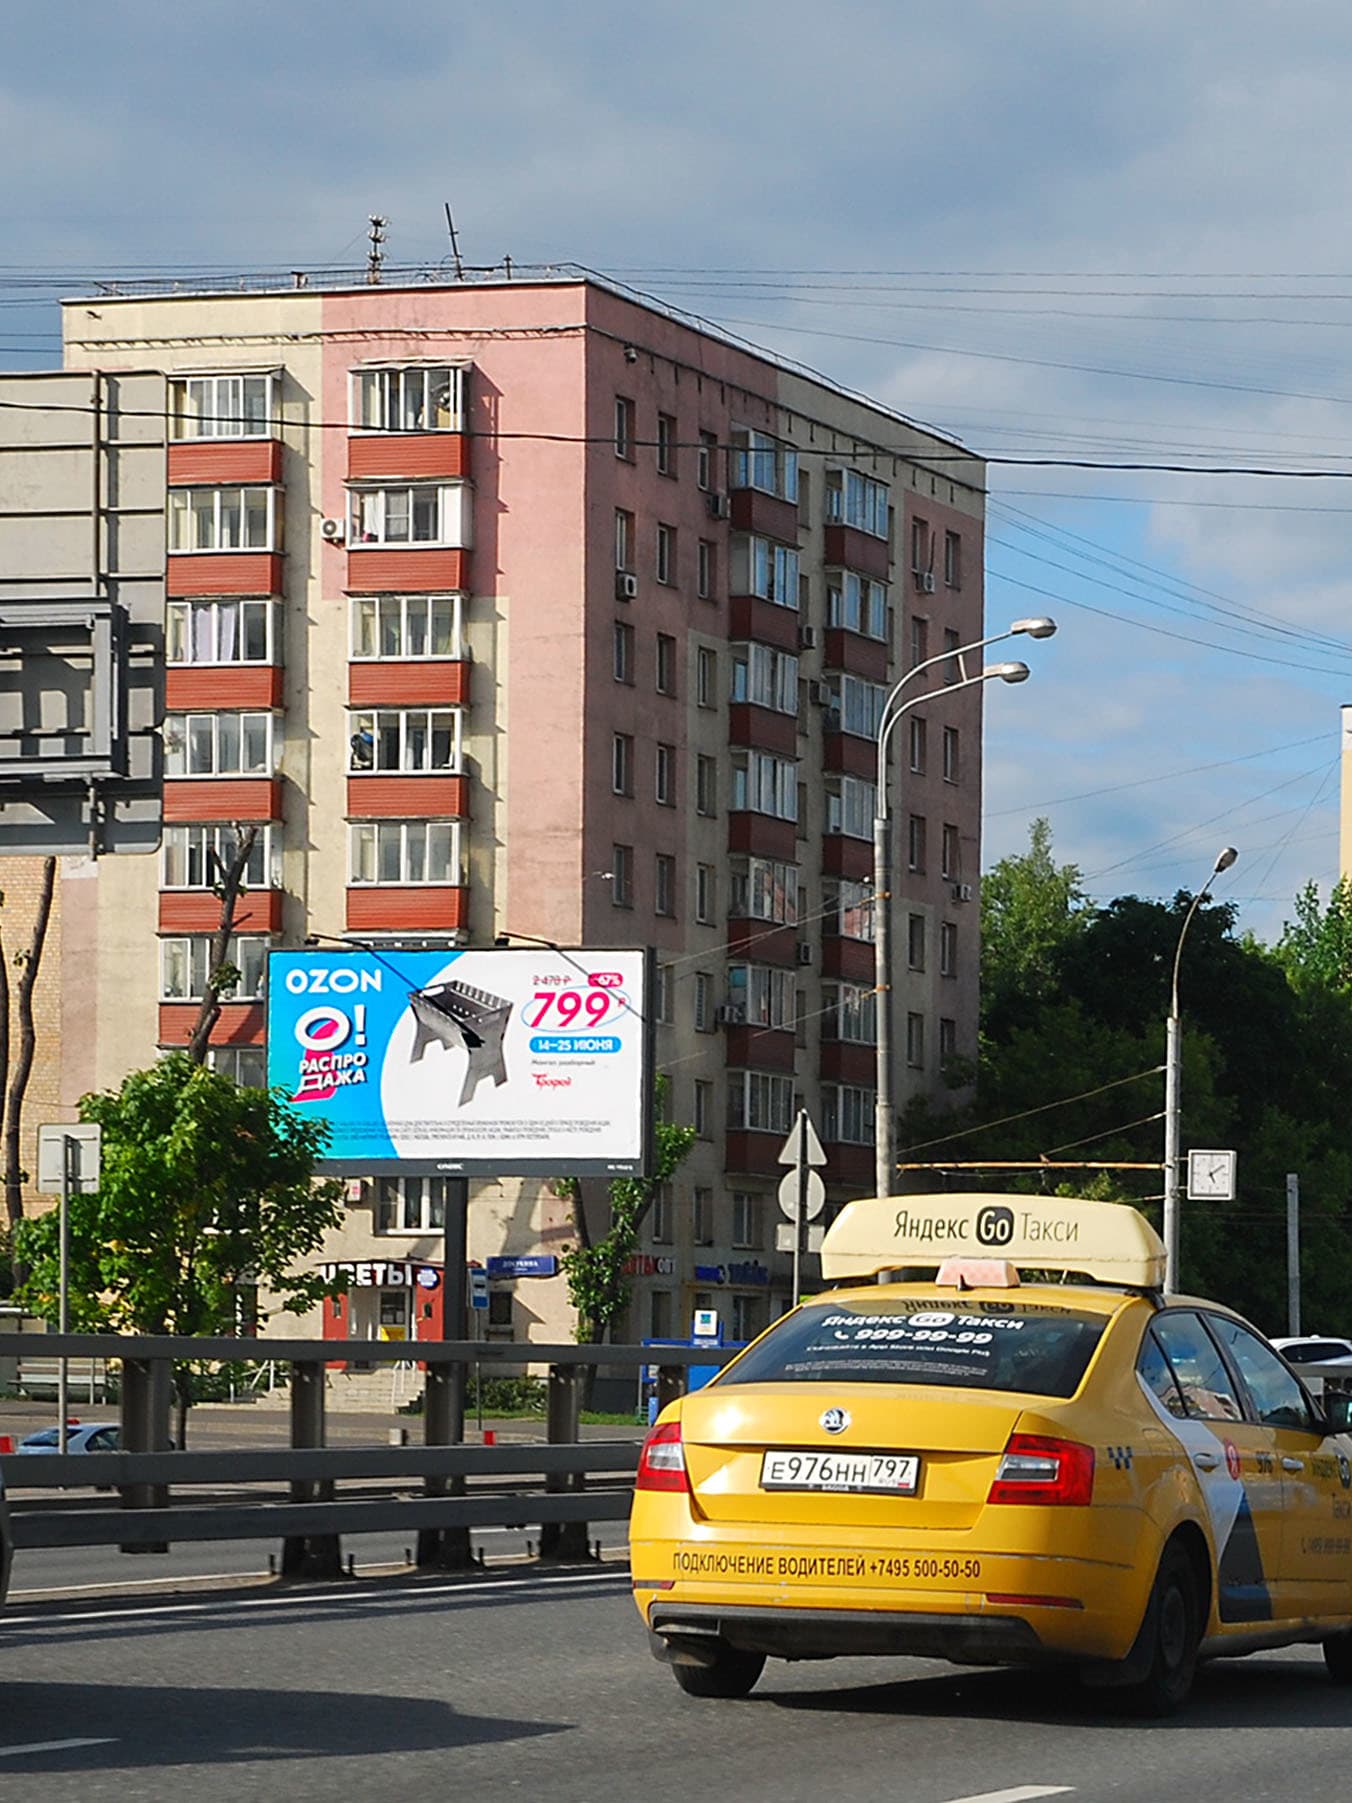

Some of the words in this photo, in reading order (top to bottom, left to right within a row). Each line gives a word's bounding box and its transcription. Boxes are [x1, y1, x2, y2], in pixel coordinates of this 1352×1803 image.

[285, 968, 382, 994] OZON
[530, 991, 610, 1028] 799
[294, 1004, 367, 1052] О!
[573, 1039, 614, 1051] ИЮНЯ
[299, 1052, 368, 1075] РАСПРО
[296, 1068, 367, 1092] ДАЖА
[893, 1209, 969, 1242] Яндекс
[978, 1209, 1010, 1242] Go
[1021, 1212, 1079, 1242] Такси
[821, 1314, 907, 1328] Яндекс
[957, 1314, 1025, 1330] Такси
[854, 1329, 993, 1345] 999-99-99
[770, 1456, 868, 1483] Е976НН
[873, 1458, 910, 1479] 797
[673, 1552, 774, 1575] ПОДКЛЮЧЕНИЕ
[778, 1554, 865, 1579] ВОДИТЕЛЕЙ
[869, 1558, 910, 1577] +7495
[913, 1559, 981, 1578] 500-50-50
